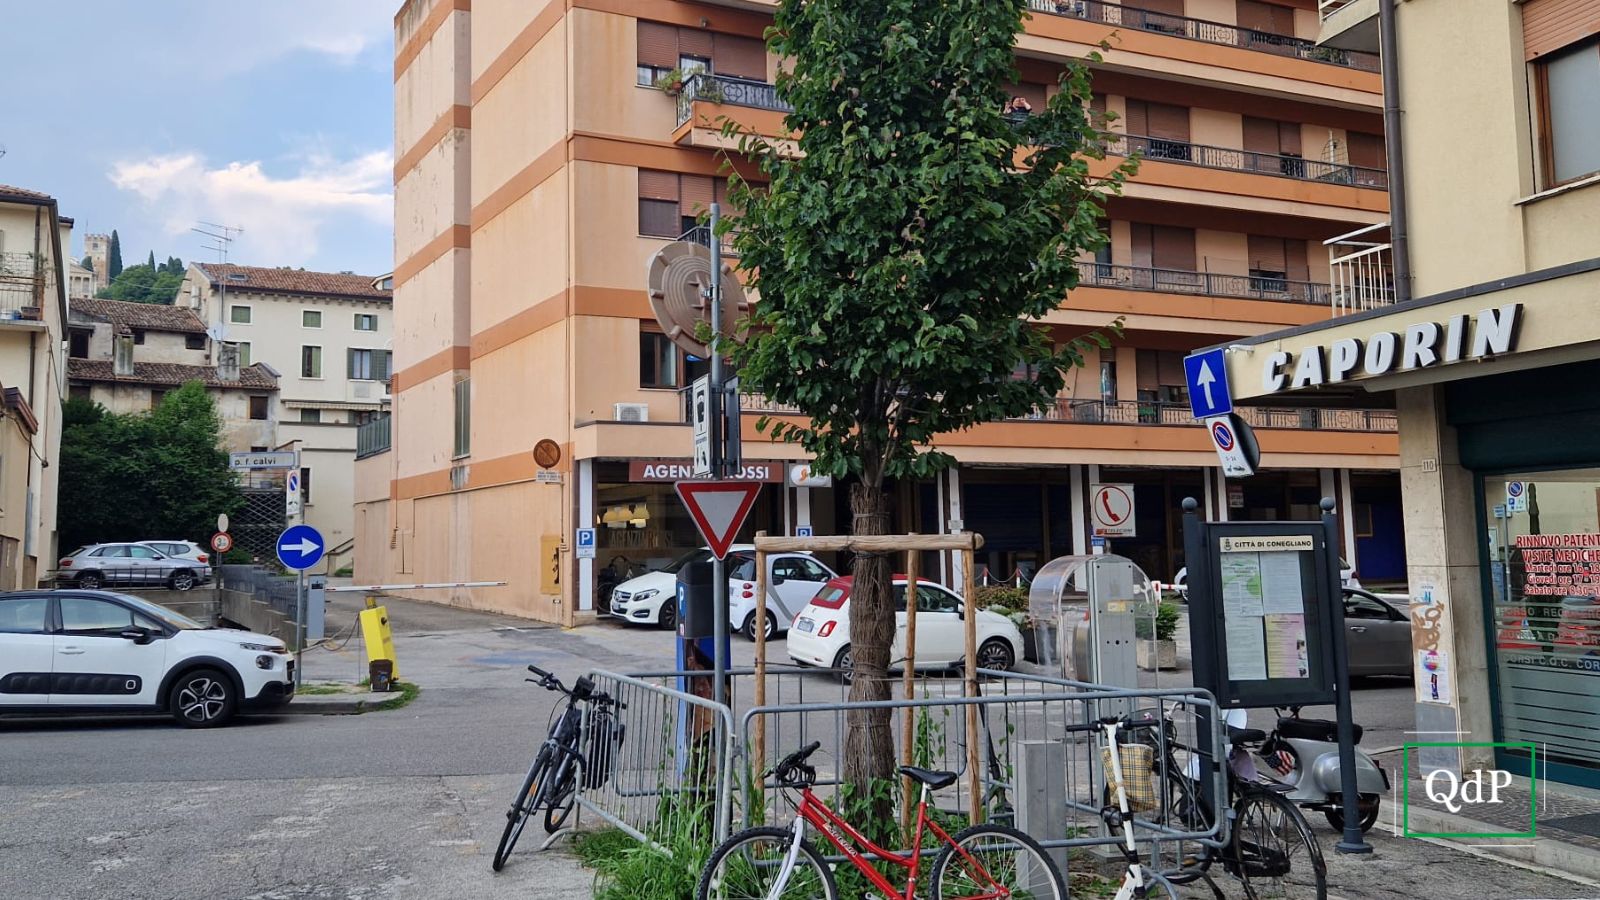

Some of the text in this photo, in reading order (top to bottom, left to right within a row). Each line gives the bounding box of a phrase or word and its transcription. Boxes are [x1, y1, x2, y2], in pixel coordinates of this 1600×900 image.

[1263, 303, 1523, 392] CAPORIN
[253, 457, 276, 465] calvi
[1423, 460, 1434, 470] 110
[643, 464, 769, 479] AGEN OSSI
[1516, 535, 1560, 547] RINNOVO
[1522, 550, 1600, 562] VISITE MEDICHE
[1558, 565, 1572, 573] ore
[1558, 576, 1572, 584] ore
[1524, 584, 1552, 595] Sabato
[1554, 587, 1568, 595] ore
